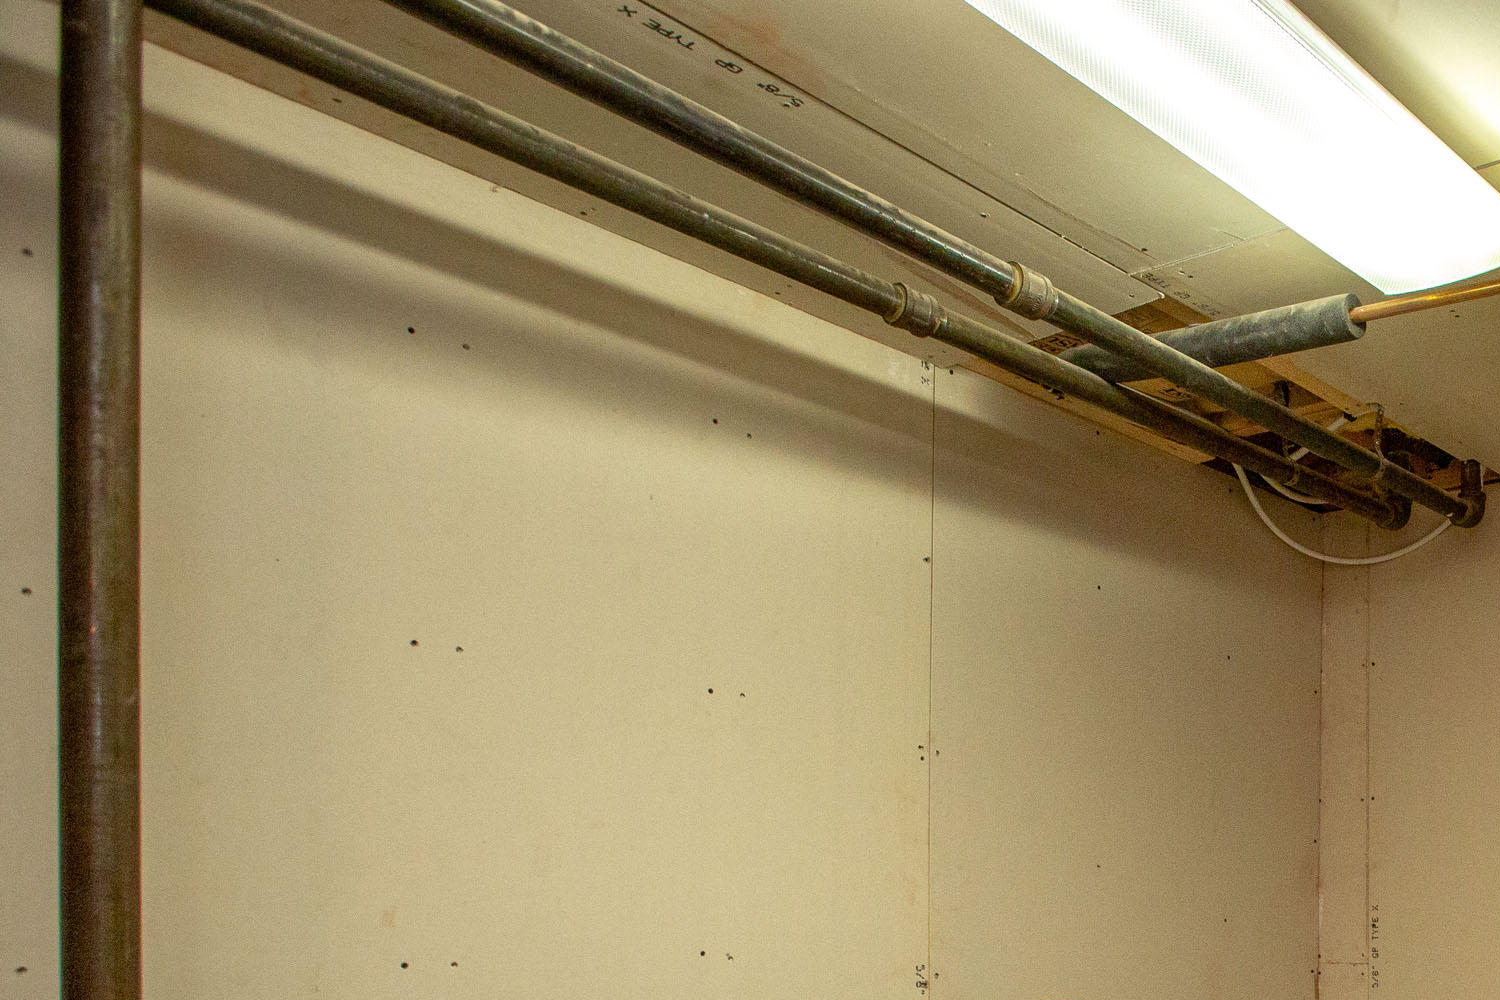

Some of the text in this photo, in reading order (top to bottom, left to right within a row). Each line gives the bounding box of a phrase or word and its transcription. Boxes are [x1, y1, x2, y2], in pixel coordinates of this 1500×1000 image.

[617, 5, 804, 108] 5/8" GP TYPE X
[1372, 947, 1379, 958] GP
